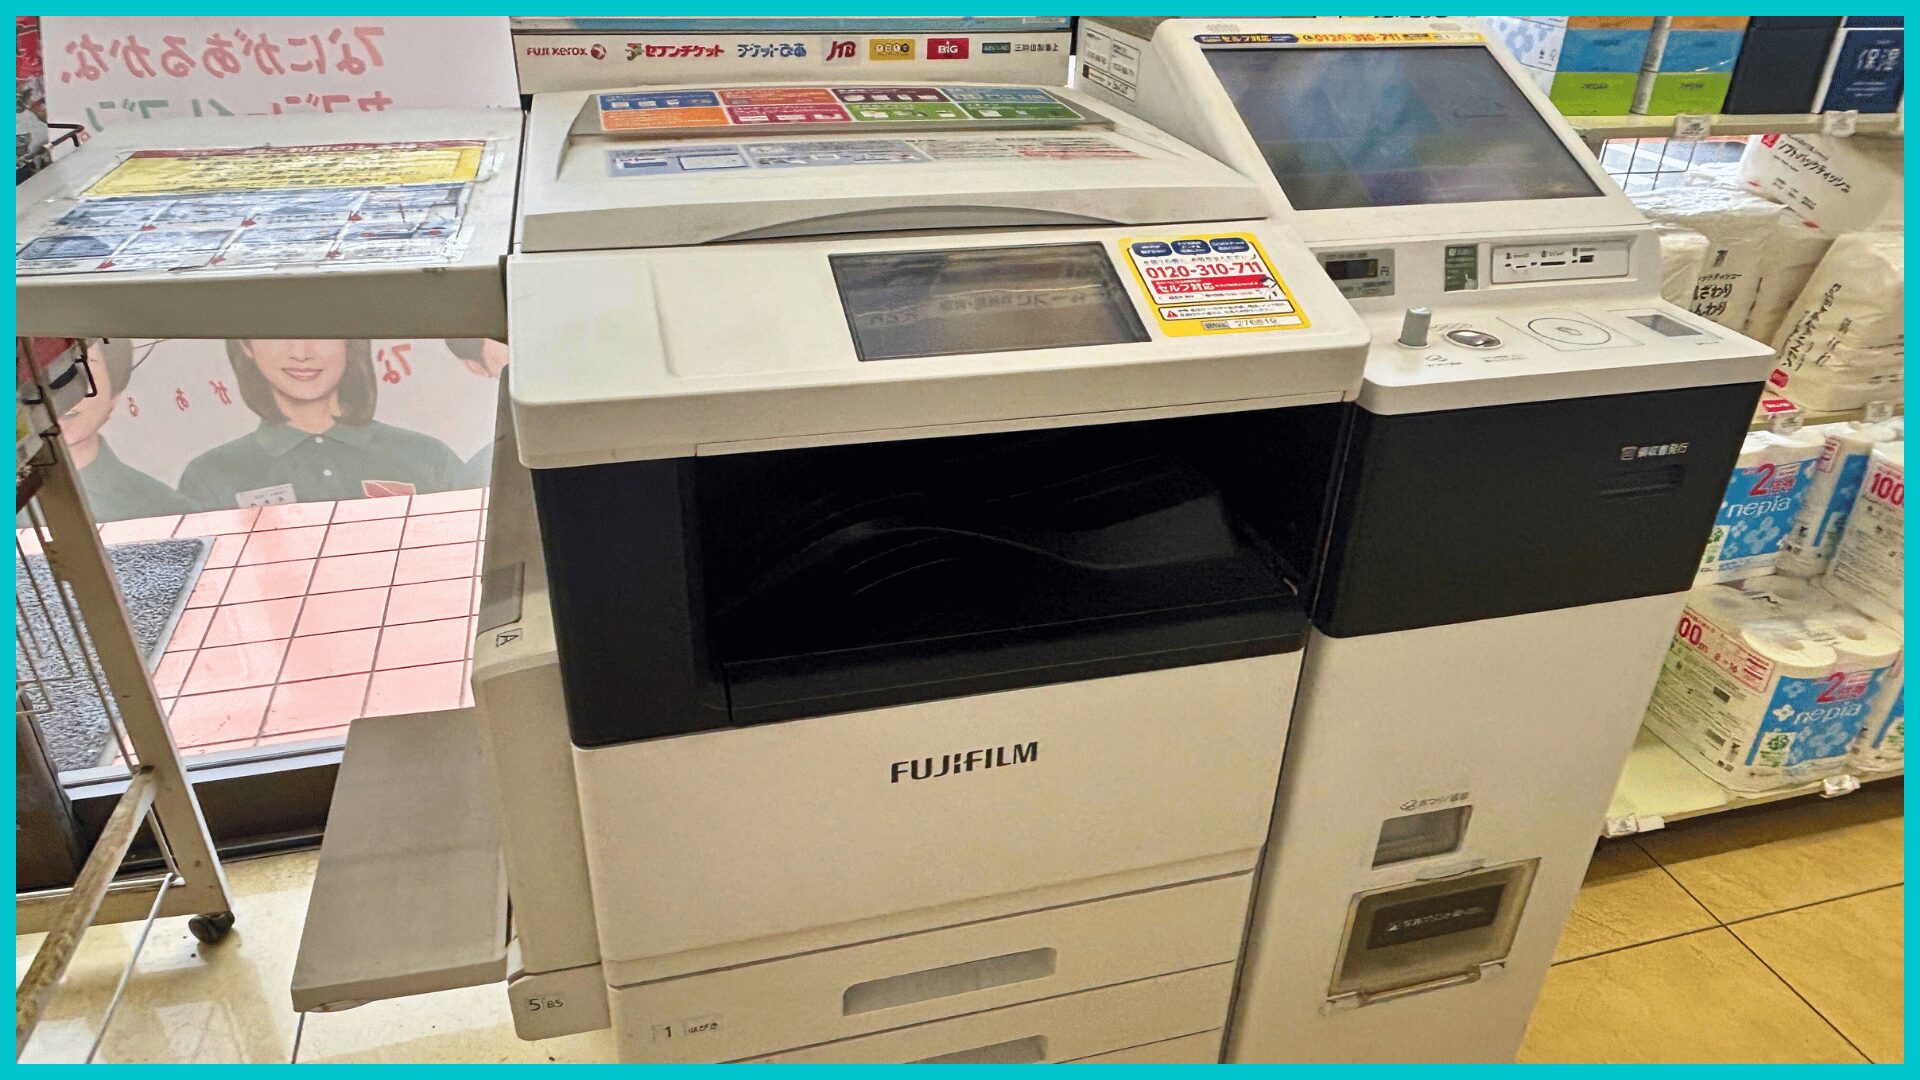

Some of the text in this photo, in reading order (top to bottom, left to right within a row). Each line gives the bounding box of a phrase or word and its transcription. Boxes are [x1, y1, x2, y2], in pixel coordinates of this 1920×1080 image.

[527, 47, 550, 56] FUJI
[645, 43, 725, 58] セブンチケット
[826, 40, 856, 61] JTB
[1146, 262, 1263, 279] 0120-310-711
[1750, 463, 1776, 496] 2
[1727, 496, 1791, 518] nepia
[500, 634, 519, 646] A
[1816, 671, 1845, 703] 2
[1793, 702, 1862, 725] nepia
[891, 741, 1039, 784] FUJIFILM
[529, 998, 541, 1011] 5
[664, 1026, 671, 1038] 1
